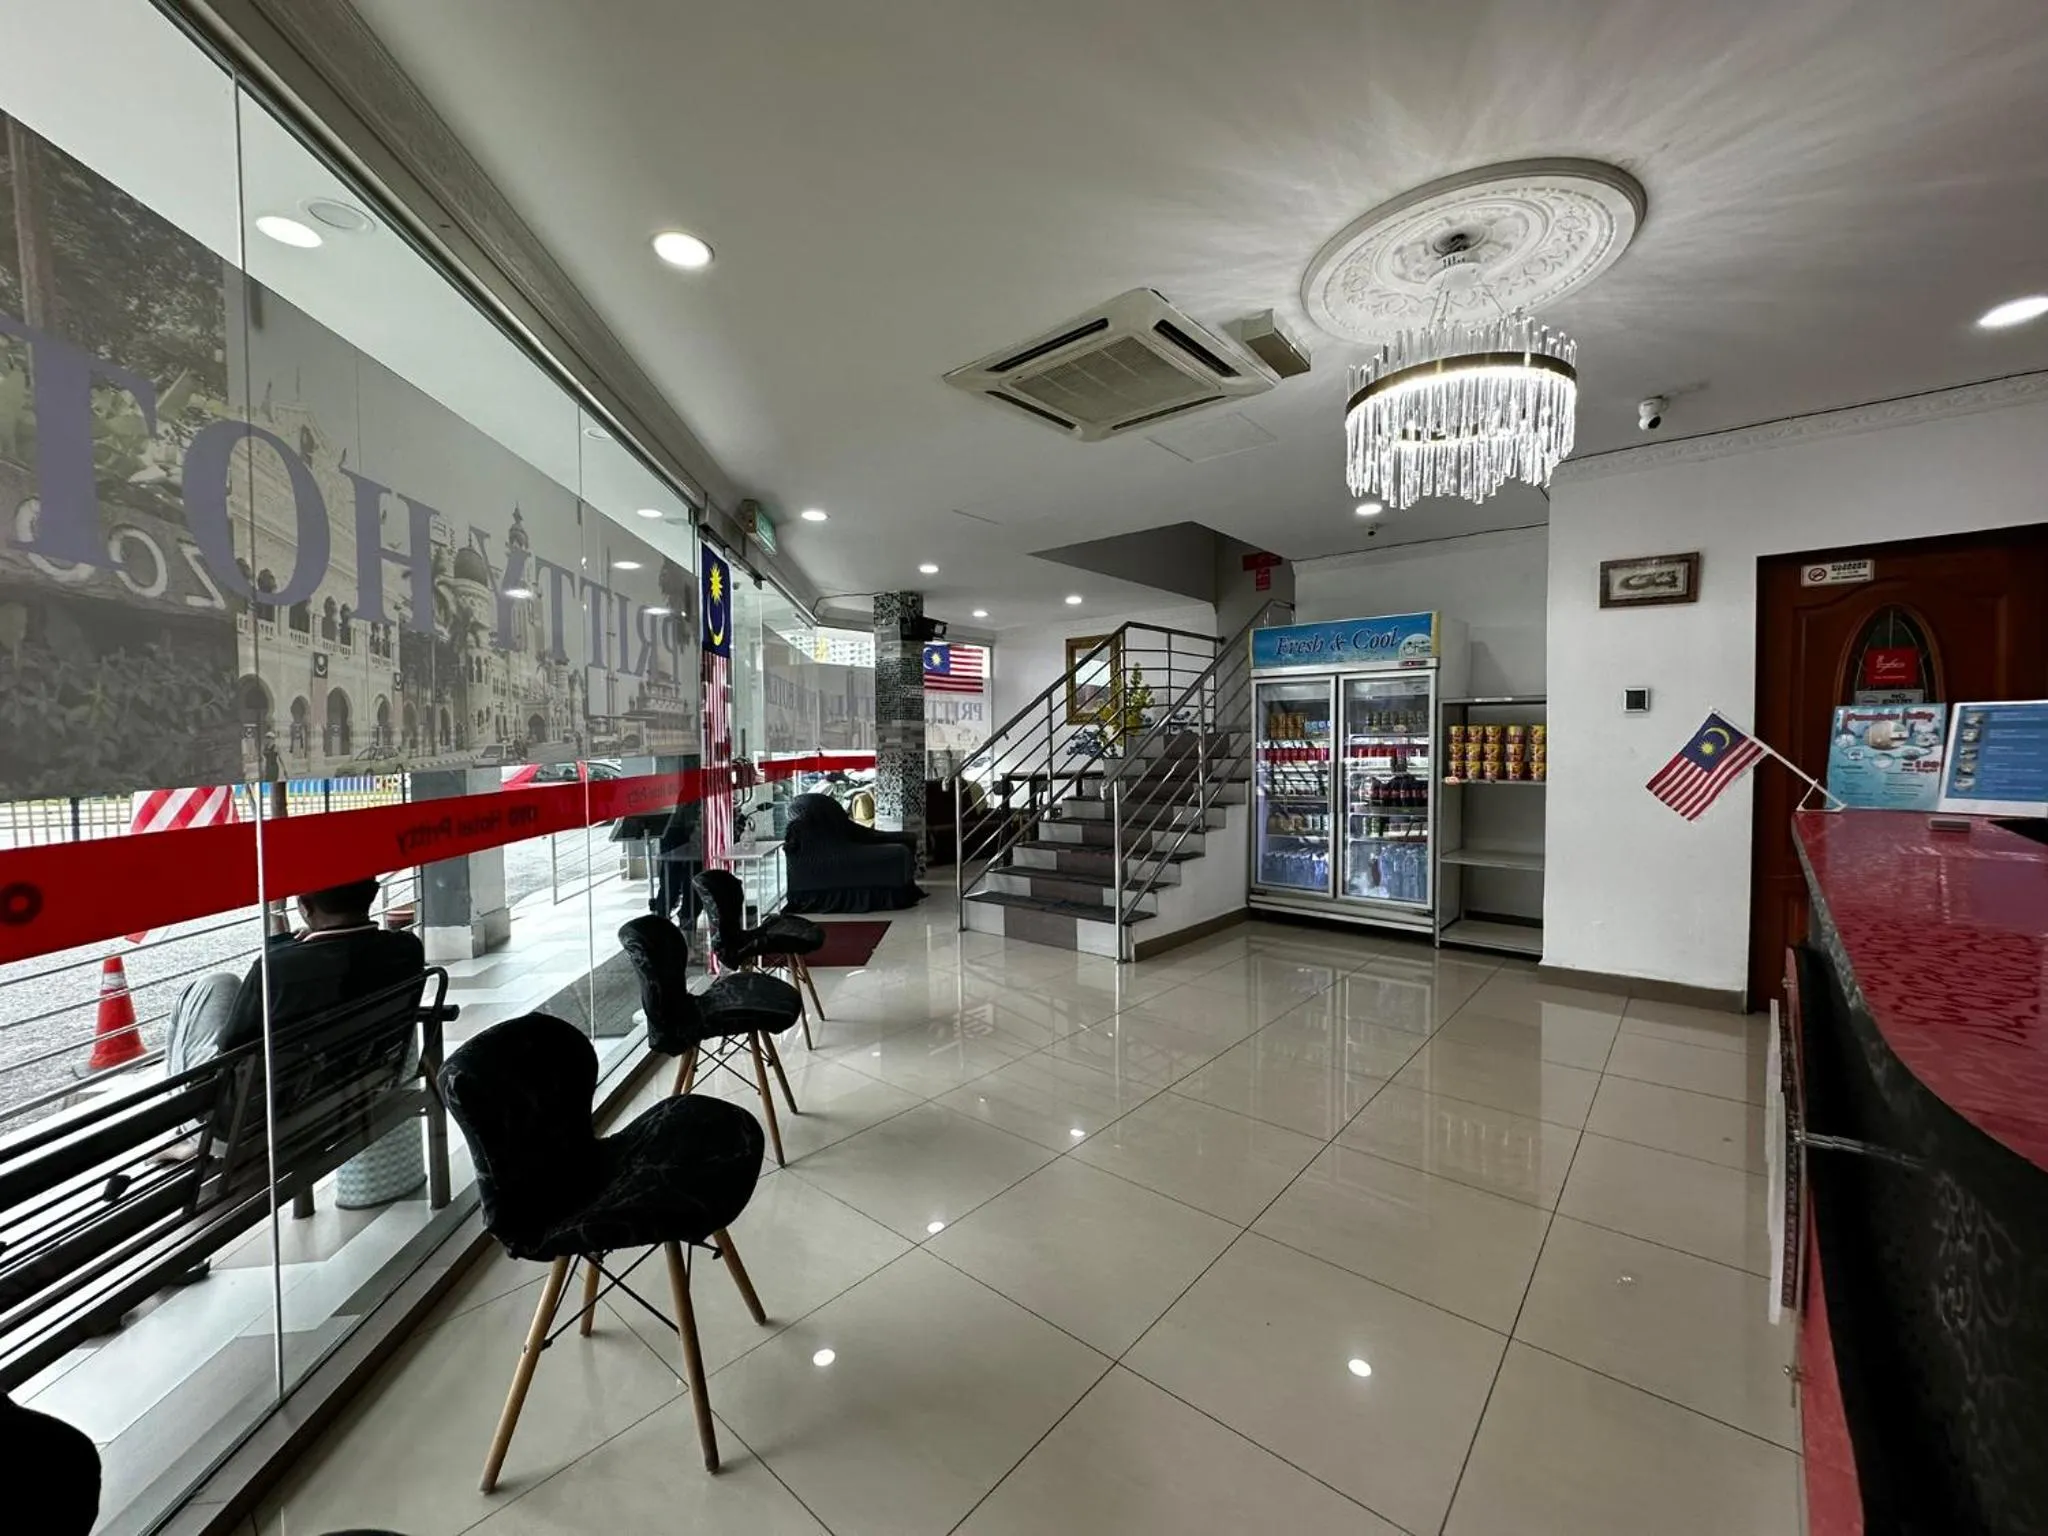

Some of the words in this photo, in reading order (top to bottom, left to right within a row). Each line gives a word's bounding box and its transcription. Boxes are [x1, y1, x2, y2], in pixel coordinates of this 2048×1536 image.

[1276, 633, 1324, 655] Fresh
[1330, 634, 1346, 650] &
[1352, 625, 1399, 650] Cool
